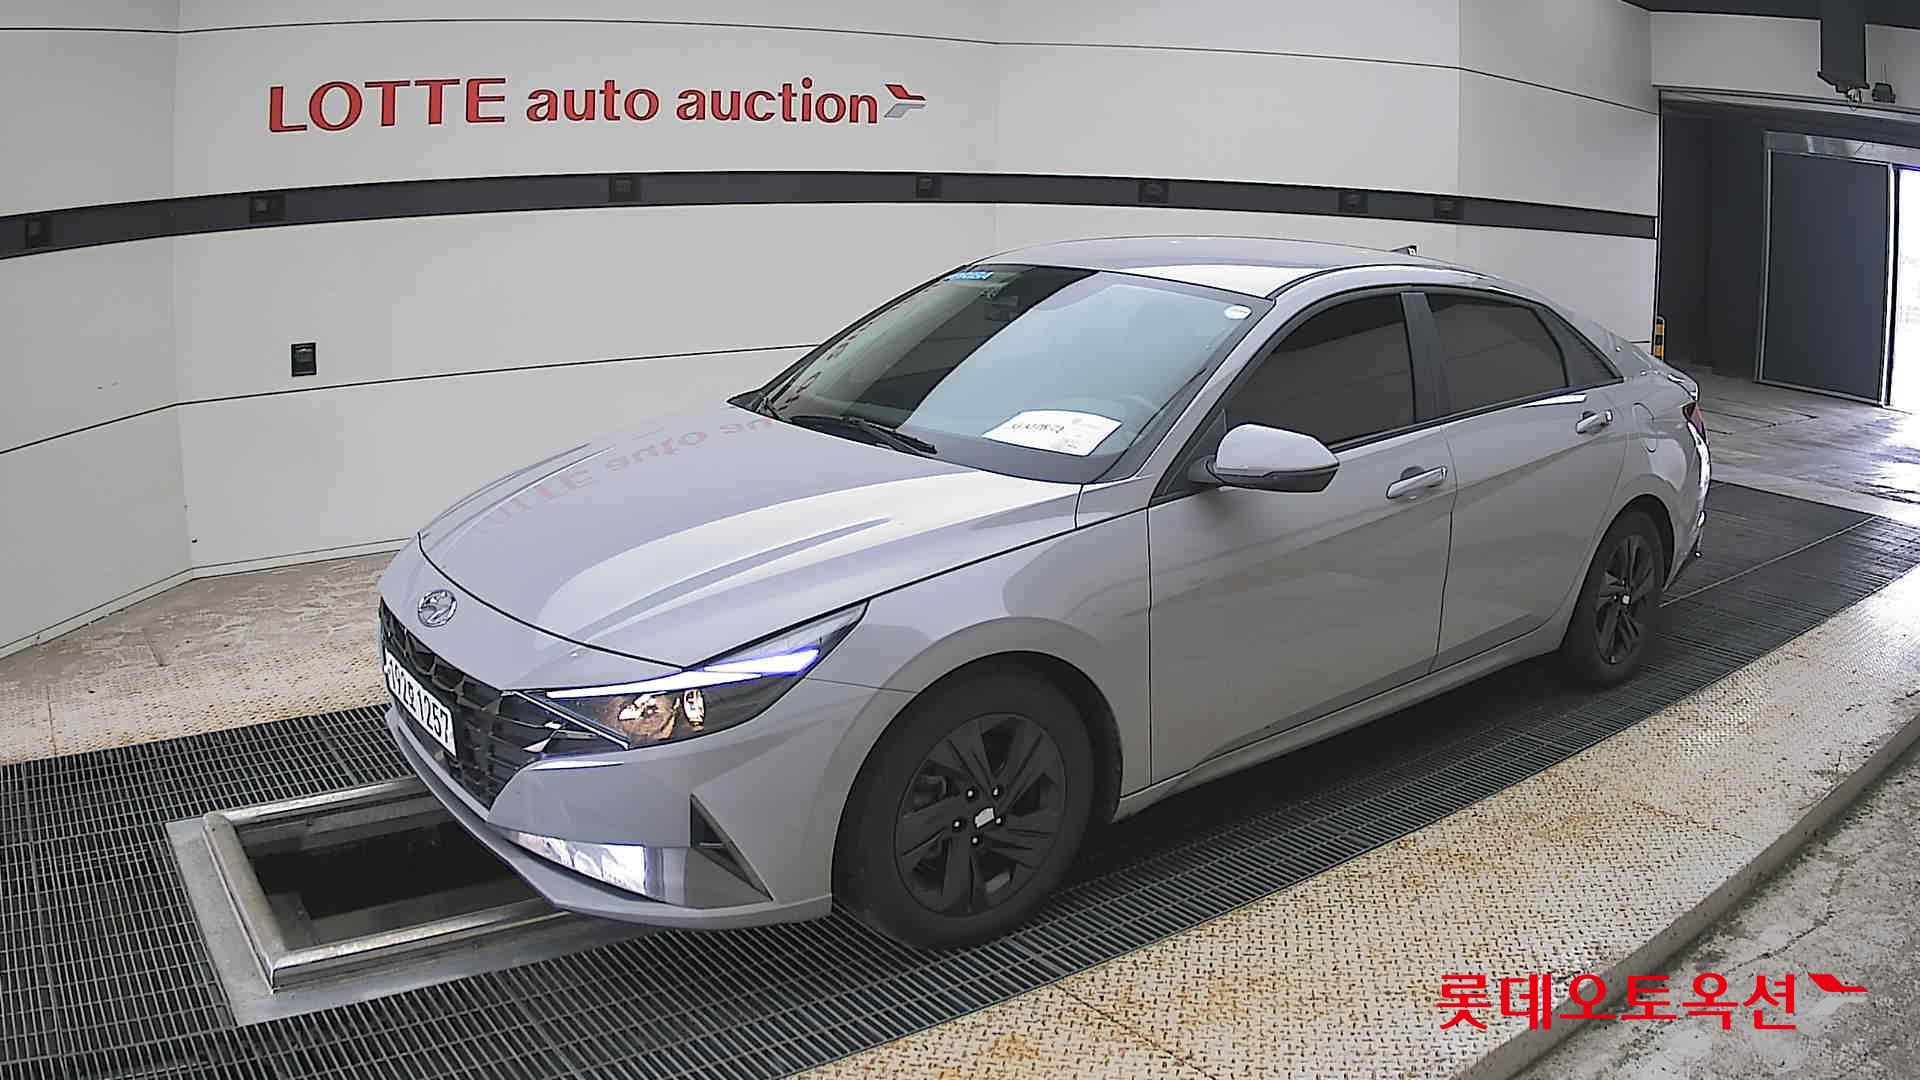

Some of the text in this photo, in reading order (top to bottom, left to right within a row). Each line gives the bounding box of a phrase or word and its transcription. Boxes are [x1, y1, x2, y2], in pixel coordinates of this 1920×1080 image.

[269, 77, 879, 134] LOTTE auto auction
